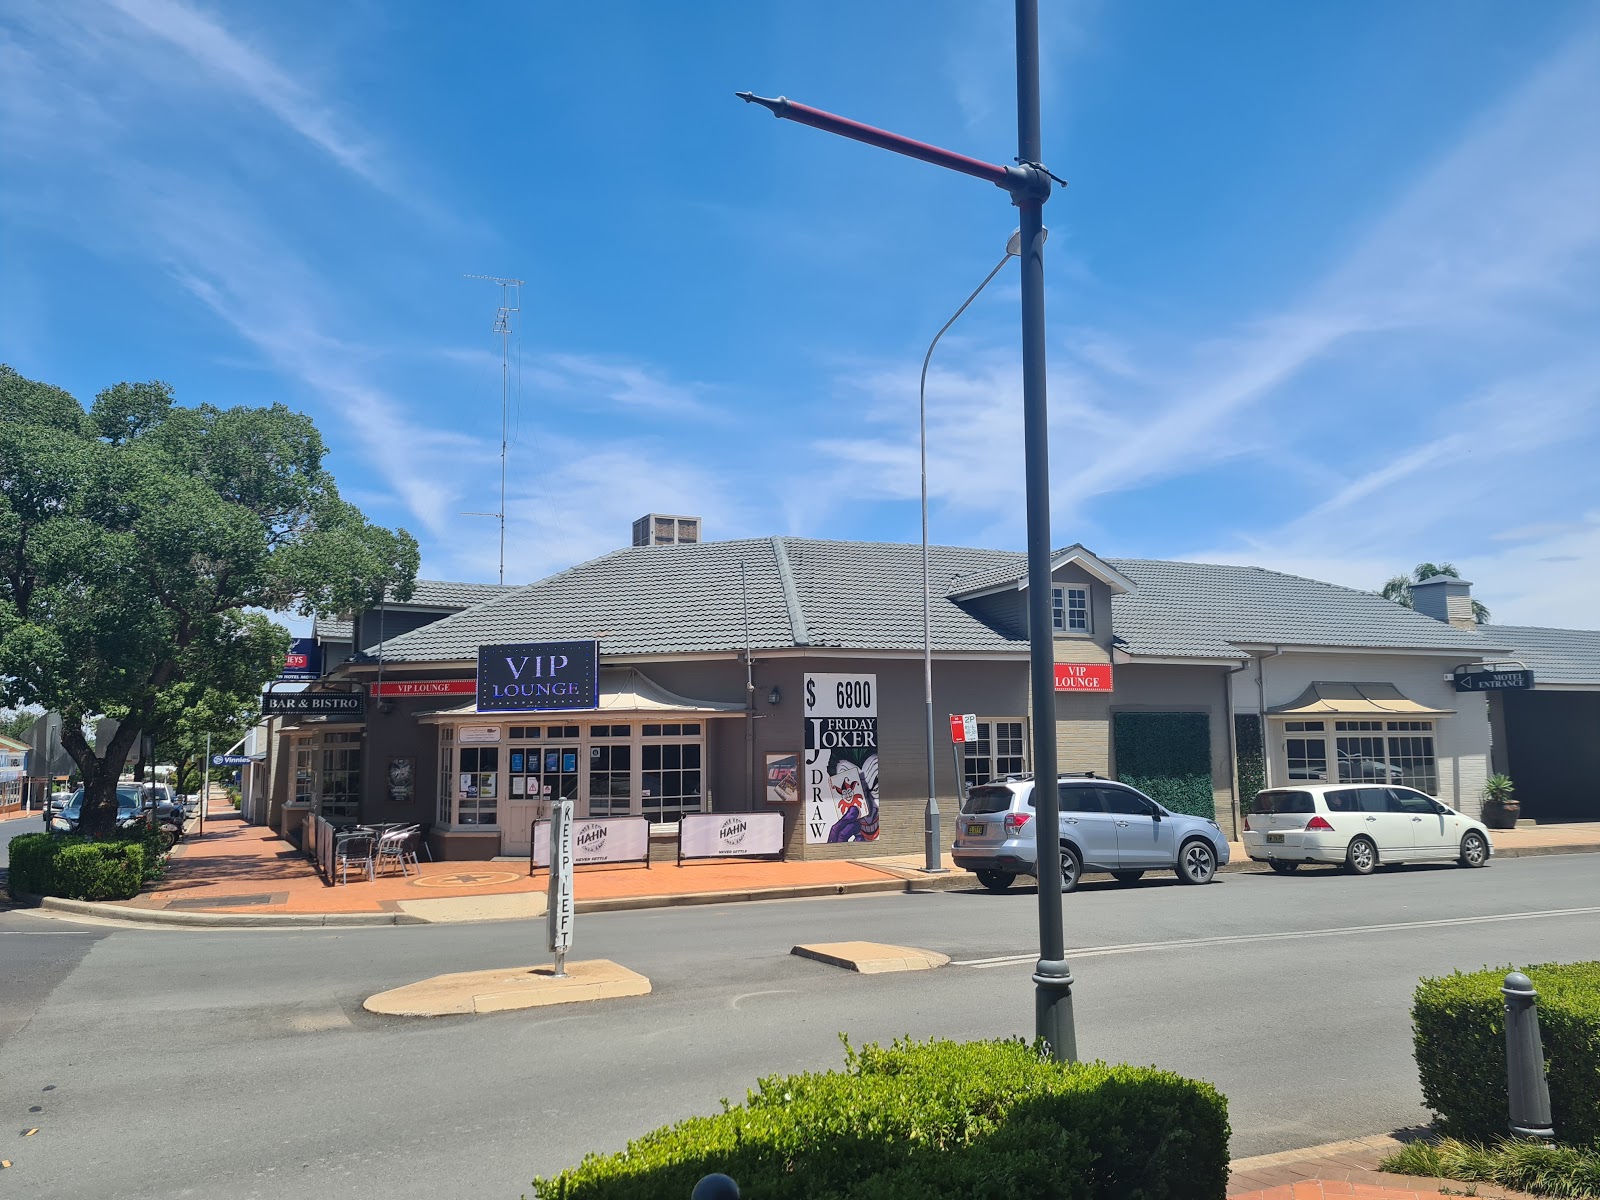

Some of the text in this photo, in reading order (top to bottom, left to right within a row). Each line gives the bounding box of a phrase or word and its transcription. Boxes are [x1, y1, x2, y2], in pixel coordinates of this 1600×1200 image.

[505, 654, 569, 680] VIP
[1068, 666, 1087, 677] VIP
[1055, 676, 1100, 687] LOUNGE
[1478, 680, 1525, 688] ENTRANCE
[1493, 673, 1525, 681] MOTEL
[398, 683, 451, 693] VIP LOUNGE
[493, 682, 580, 698] LOUNGE
[806, 677, 871, 711] $ 6800
[269, 698, 358, 708] BAR & BISTRO
[827, 718, 876, 731] FRIDAY
[806, 718, 877, 765] JOKER
[810, 769, 826, 838] DRAW
[562, 806, 571, 869] KEEP
[577, 827, 608, 846] HAHN
[720, 821, 747, 839] HAHN
[561, 882, 569, 946] LEFT
